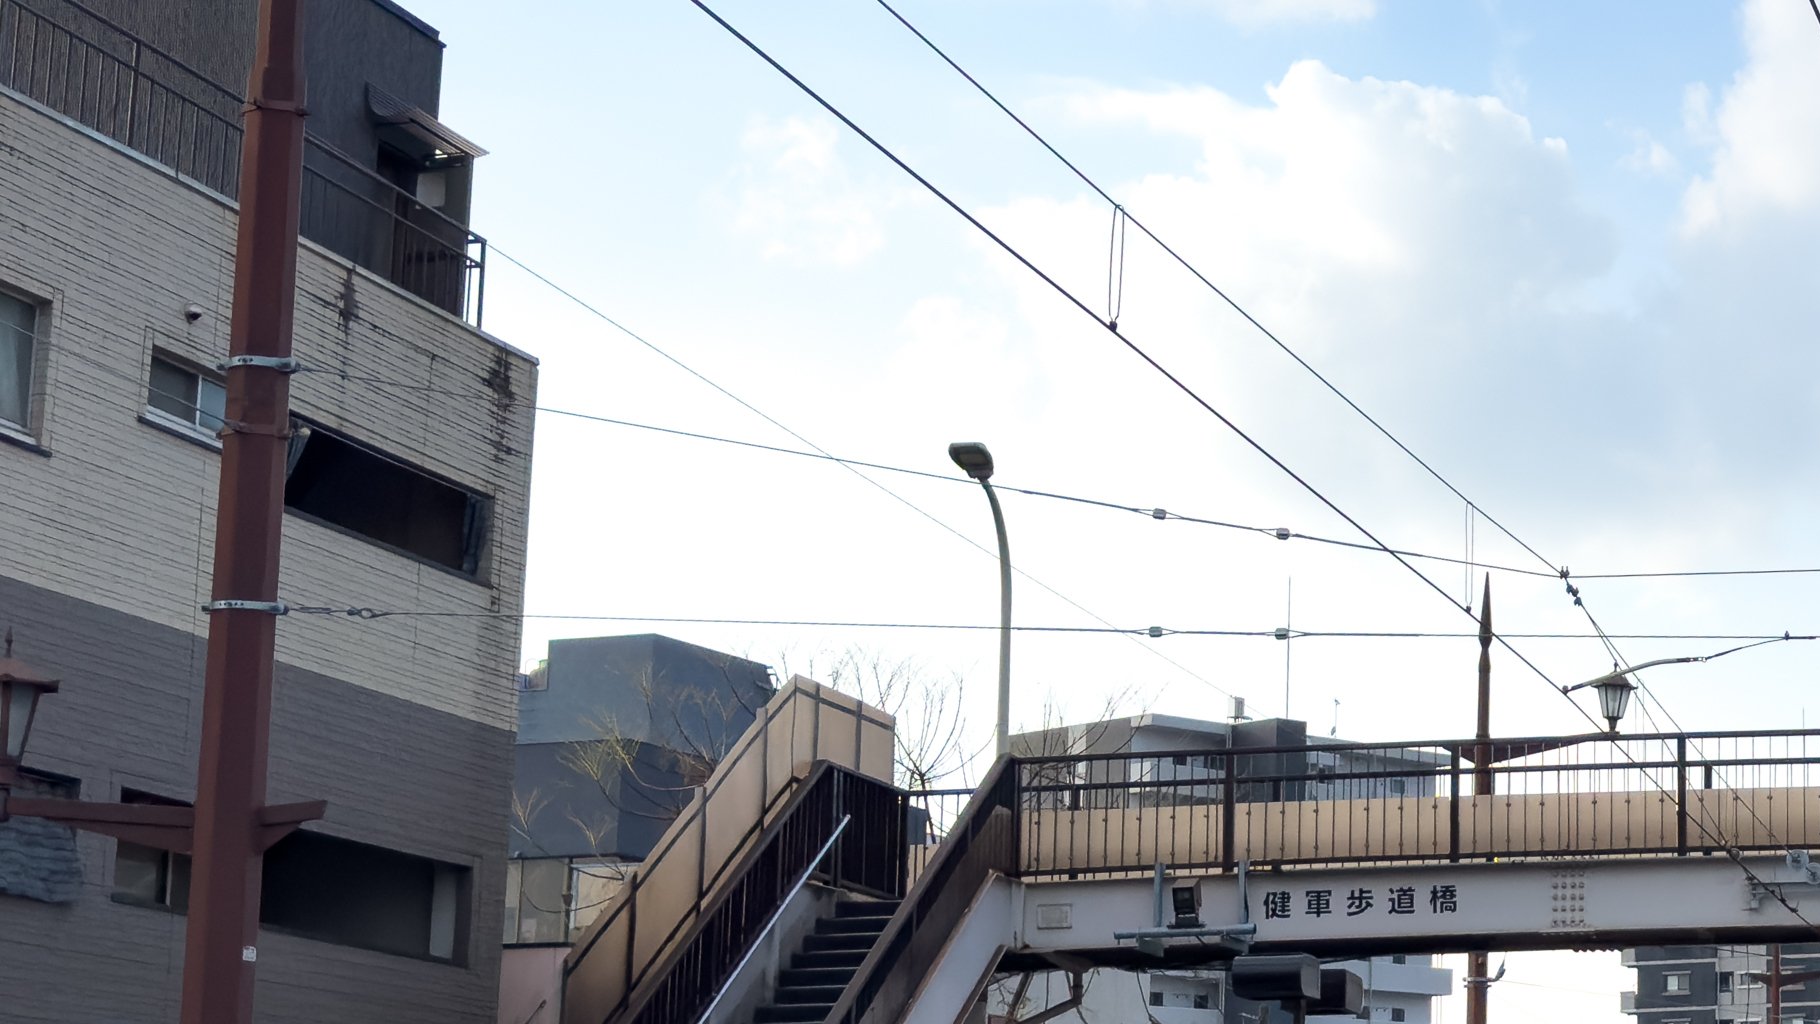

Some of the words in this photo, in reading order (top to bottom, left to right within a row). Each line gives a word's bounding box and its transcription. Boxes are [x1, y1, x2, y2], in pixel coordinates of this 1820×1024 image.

[1262, 884, 1458, 920] 健軍歩道橋
